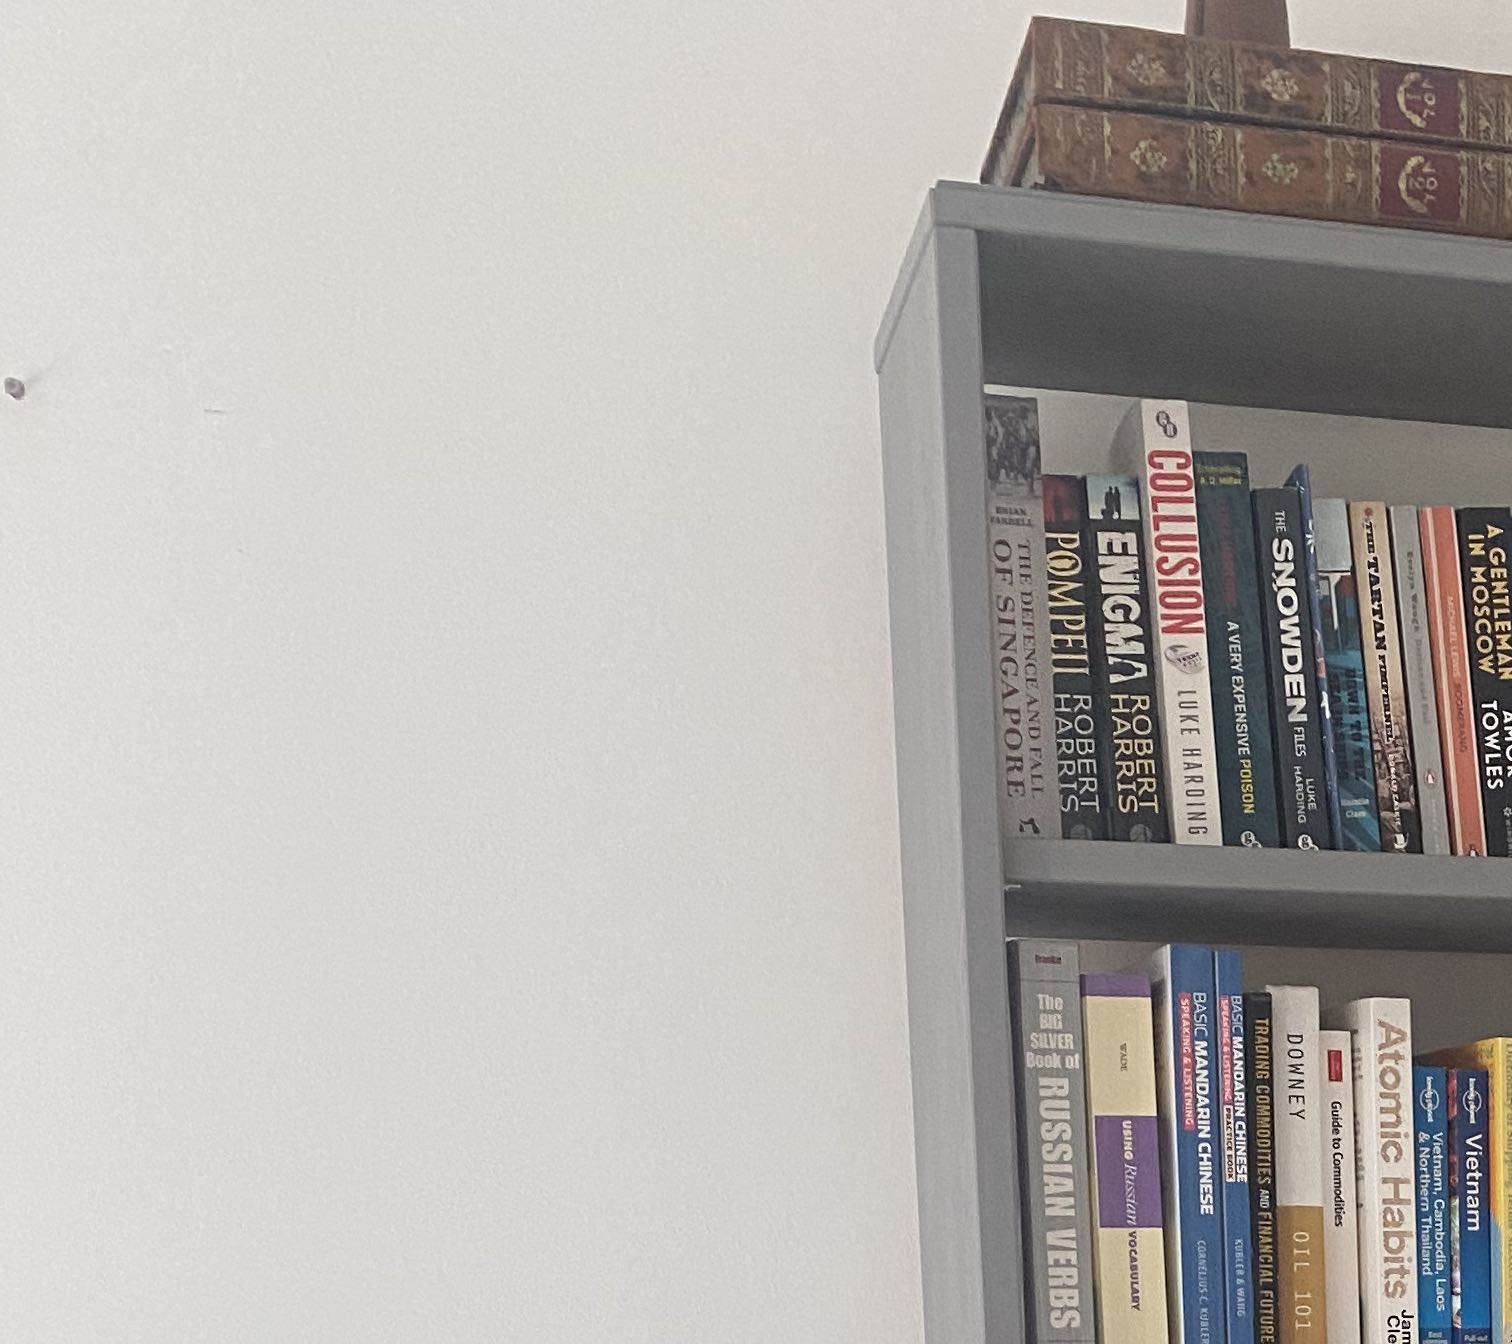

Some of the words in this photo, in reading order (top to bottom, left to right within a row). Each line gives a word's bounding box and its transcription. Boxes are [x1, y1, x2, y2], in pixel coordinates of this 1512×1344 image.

[1149, 449, 1204, 635] COLLUSION
[1274, 511, 1286, 532] THE
[1364, 521, 1374, 554] THE
[1468, 534, 1486, 556] IN
[1487, 524, 1504, 539] A
[993, 540, 1011, 583] OF
[1018, 540, 1032, 584] THE
[1045, 531, 1090, 676] POMPEII
[1097, 531, 1148, 683] ENIGMA
[1227, 622, 1238, 630] A
[1272, 538, 1307, 722] SNOWDEN
[1367, 557, 1386, 650] TARTAN
[1471, 567, 1495, 674] MOSCOW
[1019, 590, 1038, 690] DEFENCE
[1229, 634, 1243, 671] VERY
[996, 597, 1025, 797] SINGAPORE
[1027, 698, 1040, 737] AND
[1177, 690, 1196, 735] LUKE
[1232, 676, 1250, 755] EXPENSIVE
[1029, 747, 1044, 798] FALL
[1055, 695, 1078, 812] HARRIS
[1073, 695, 1099, 813] ROBERT
[1110, 694, 1137, 813] HARRIS
[1130, 695, 1158, 813] ROBERT
[1294, 727, 1307, 756] FILES
[1481, 701, 1503, 789] TOWLES
[1182, 748, 1208, 835] HARDING
[1239, 759, 1255, 814] POISON
[1294, 766, 1307, 824] HARDING
[1306, 778, 1316, 809] LUKE
[1193, 993, 1209, 1036] BASIC
[1232, 995, 1244, 1033] BASIC
[1233, 1037, 1246, 1118] MANDARIN
[1255, 1018, 1270, 1079] TRADING
[1287, 1034, 1306, 1120] DOWNEY
[1195, 1040, 1213, 1138] MANDARIN
[1331, 1101, 1344, 1135] Guide
[1377, 1020, 1408, 1163] Atomic
[1038, 1078, 1075, 1216] RUSSIAN
[1122, 1120, 1134, 1159] USING
[1236, 1121, 1248, 1182] CHINESE
[1257, 1084, 1271, 1185] COMMODITIES
[1332, 1138, 1343, 1149] to
[1420, 1132, 1431, 1144] &
[1432, 1132, 1445, 1194] Vietnam,
[1123, 1164, 1139, 1225] Russian
[1198, 1142, 1215, 1215] CHINESE
[1332, 1153, 1346, 1226] Commodities
[1420, 1147, 1431, 1210] Northern
[1465, 1135, 1483, 1231] Vietnam
[1258, 1211, 1273, 1285] FINANCIAL
[1293, 1231, 1311, 1272] OIL
[1379, 1177, 1413, 1299] Habits
[1421, 1216, 1434, 1276] Thailand
[1434, 1199, 1447, 1273] Cambodia,
[1045, 1229, 1080, 1328] VERBS
[1436, 1279, 1448, 1311] Laos
[1294, 1292, 1312, 1330] 101
